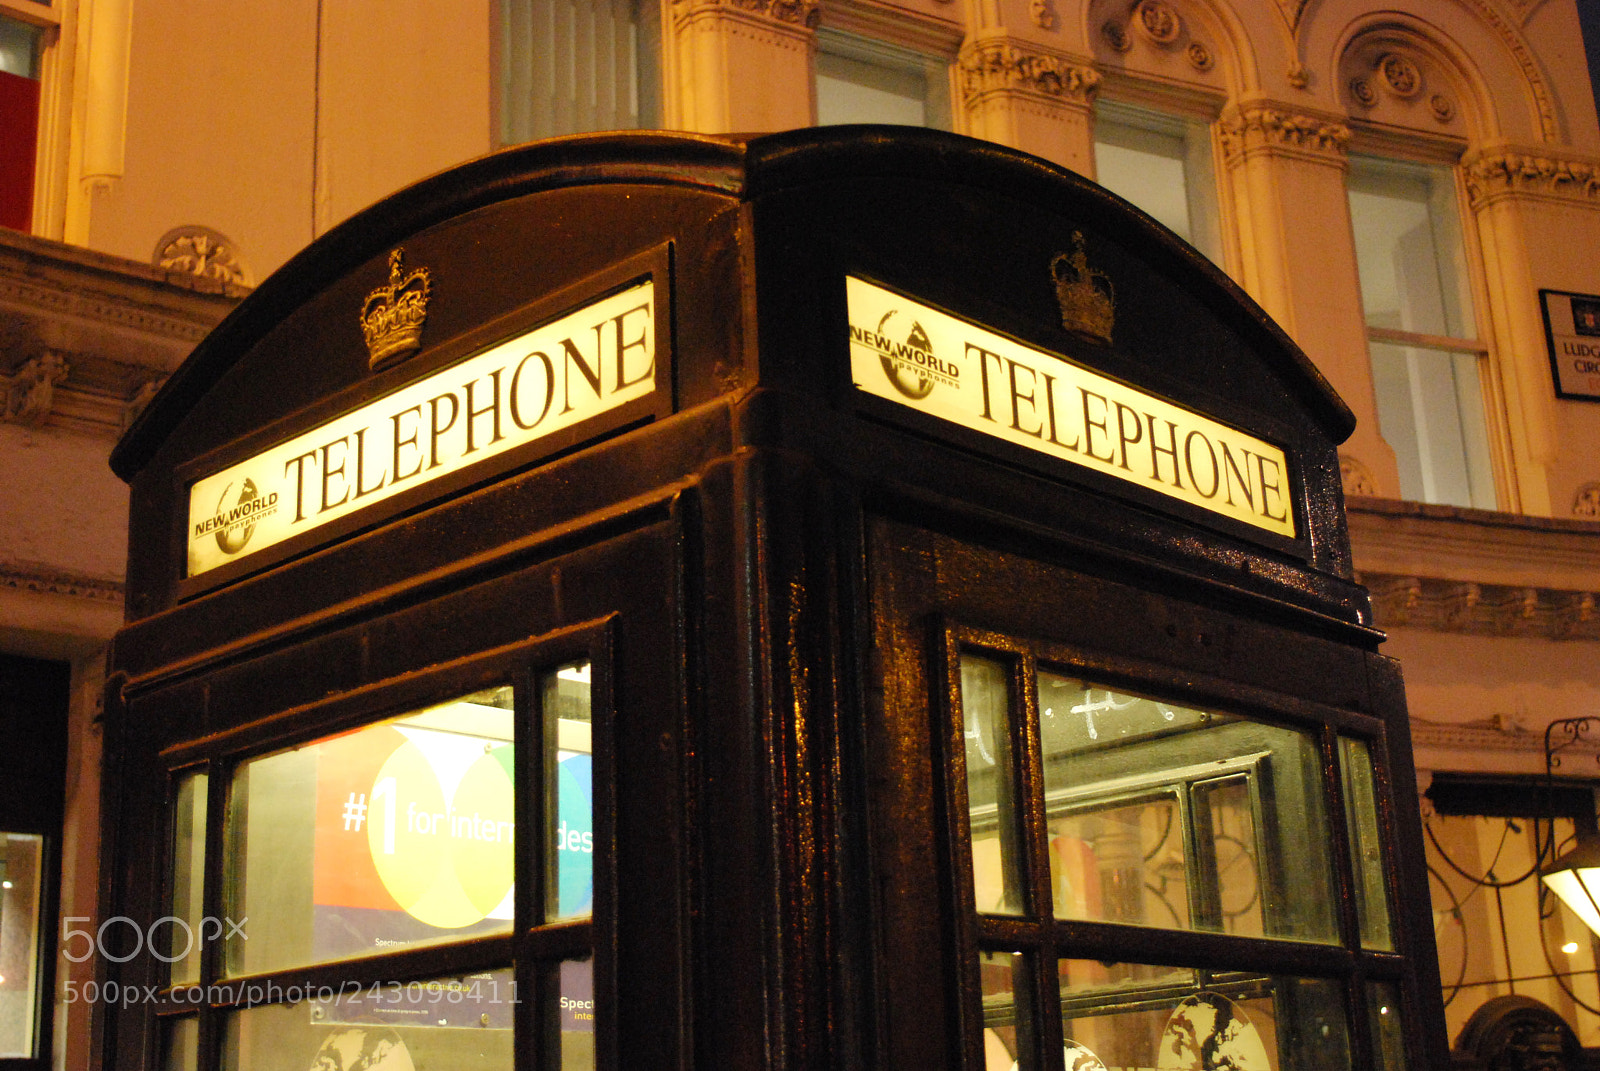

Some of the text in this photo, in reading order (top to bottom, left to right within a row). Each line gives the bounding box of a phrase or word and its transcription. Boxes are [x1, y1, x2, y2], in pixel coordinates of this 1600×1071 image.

[849, 325, 959, 378] NEW WORLD
[899, 361, 961, 390] payphones
[284, 303, 654, 525] TELEPHONE
[964, 341, 1288, 524] TELEPHONE
[195, 492, 279, 536] NEW WORLD
[229, 508, 278, 532] payphones
[407, 802, 445, 836] for
